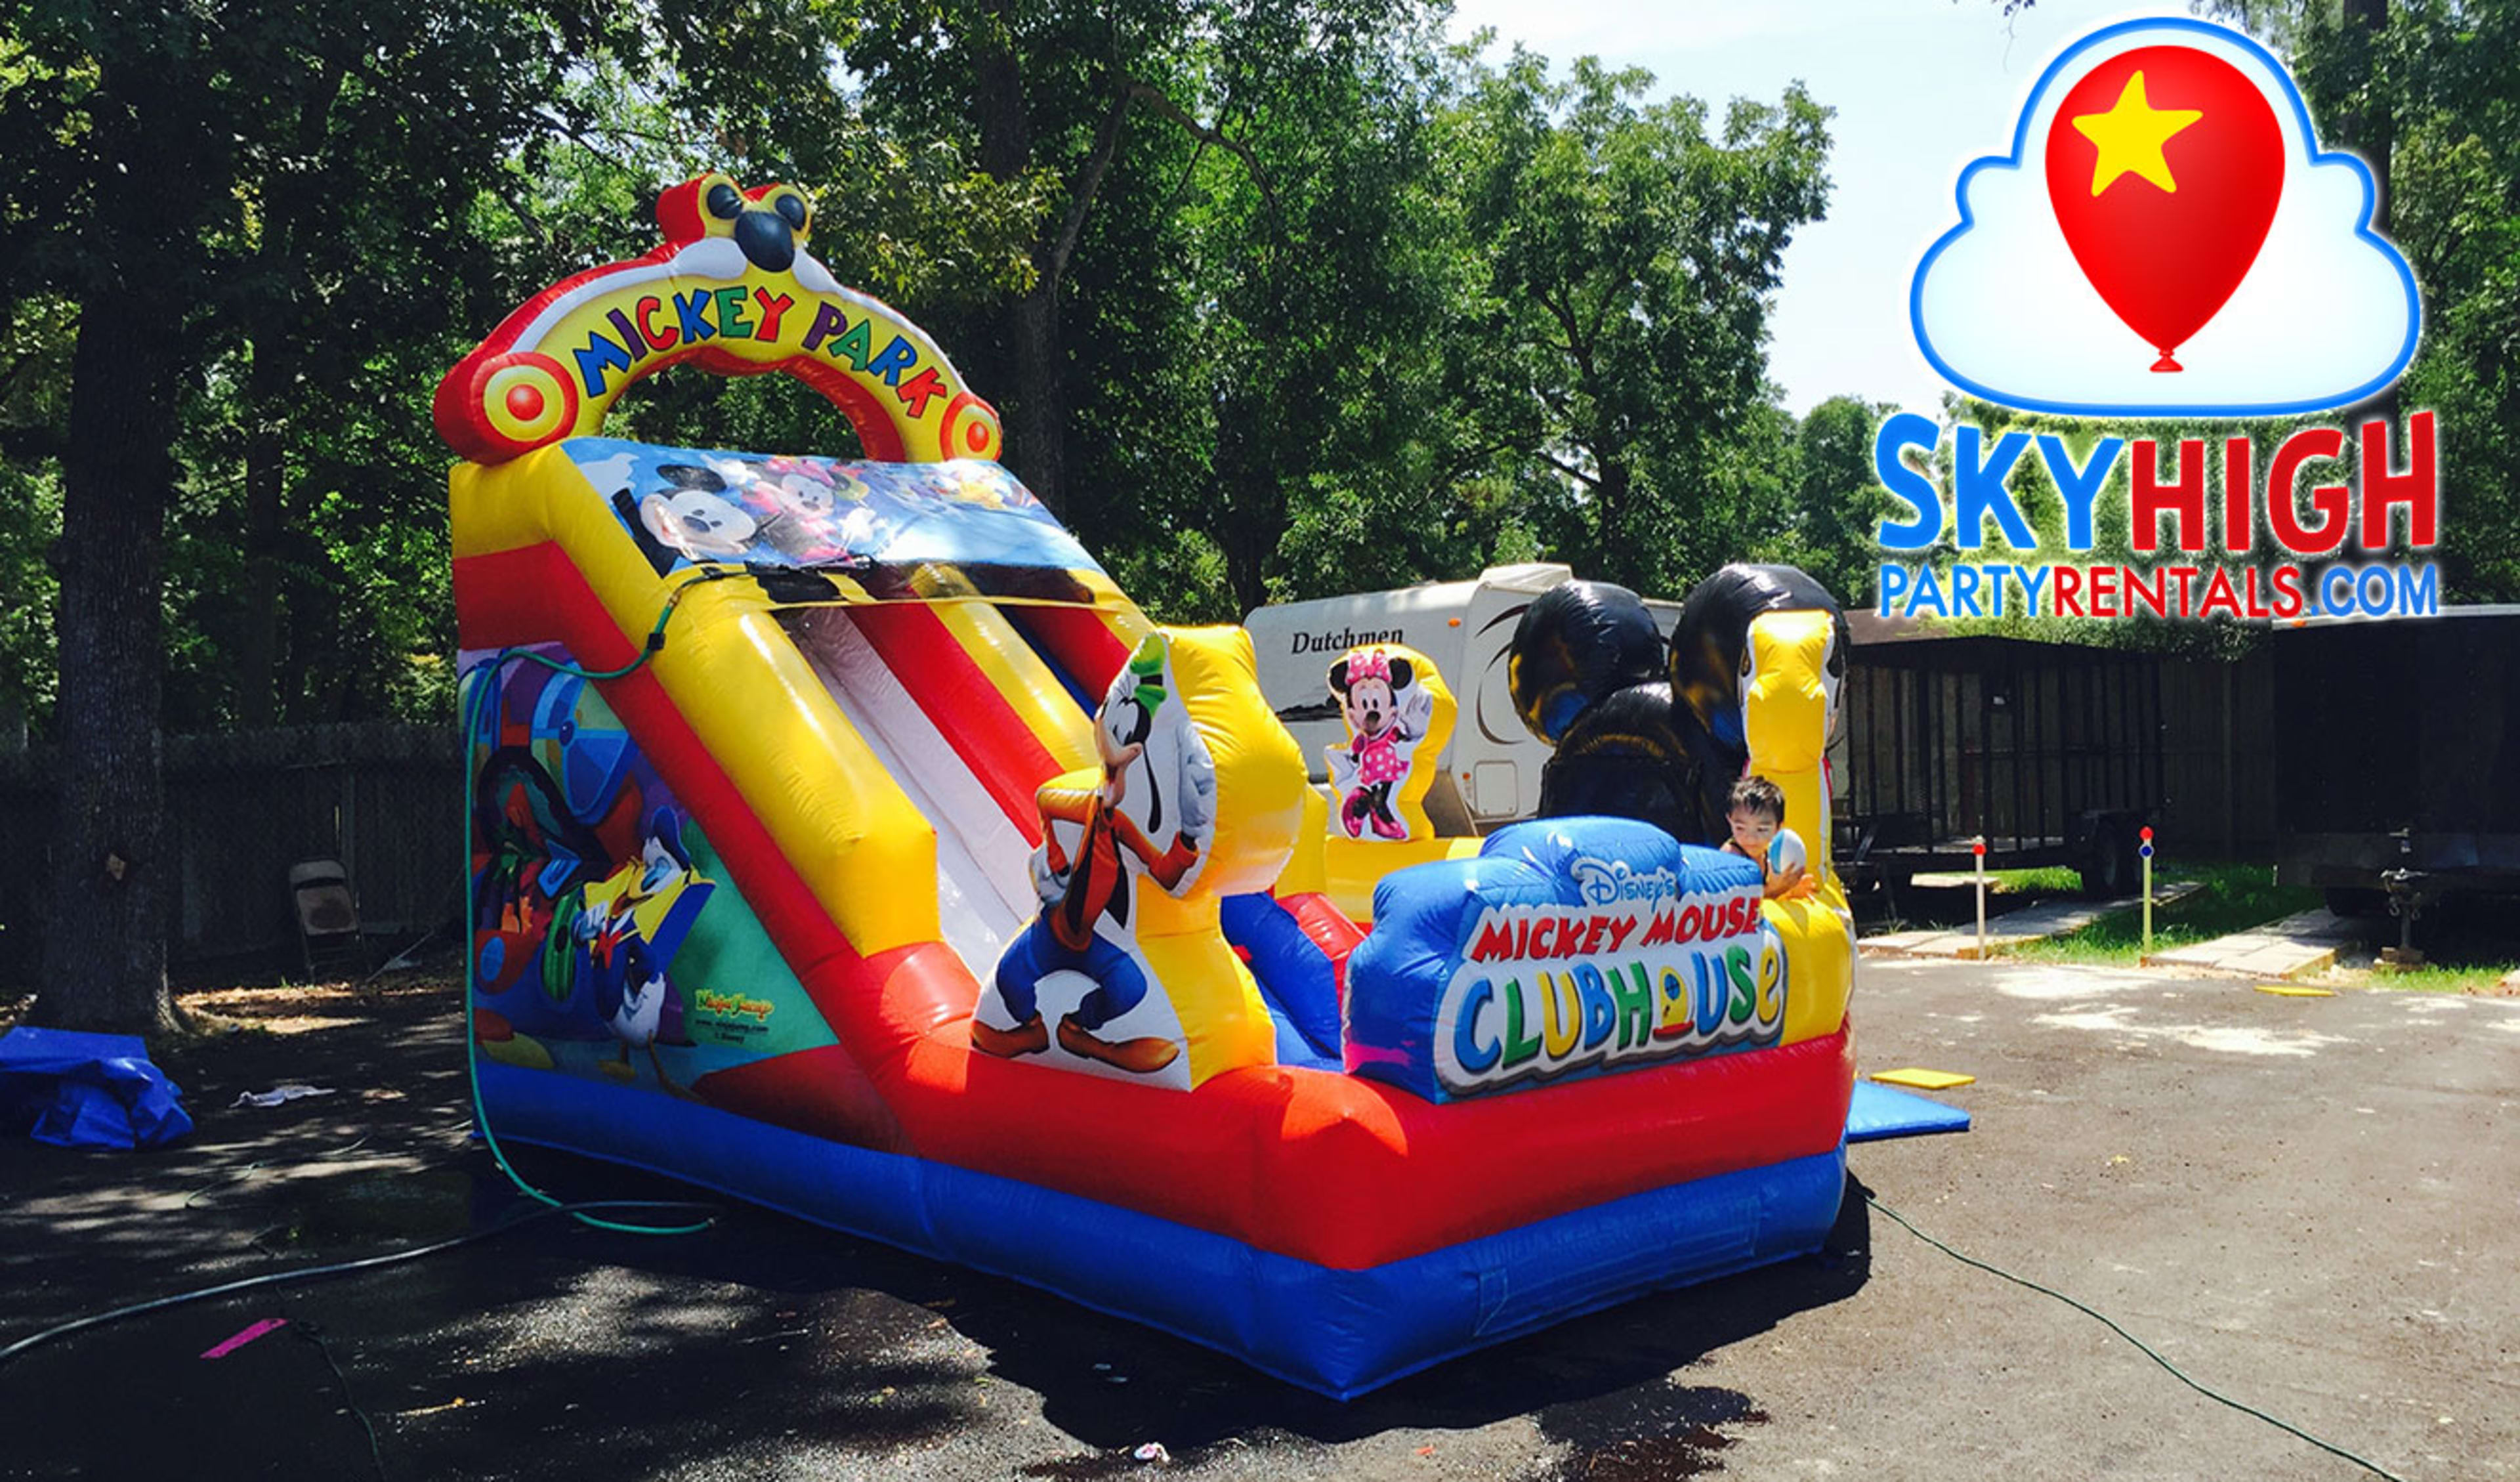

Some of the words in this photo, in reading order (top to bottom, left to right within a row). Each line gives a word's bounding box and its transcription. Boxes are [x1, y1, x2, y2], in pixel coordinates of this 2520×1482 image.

[572, 286, 795, 398] MICKEY
[801, 302, 947, 418] PARK
[1292, 627, 1404, 655] Dutchmen
[1471, 914, 1637, 963] MICKEY
[1641, 897, 1761, 947] MOUSE
